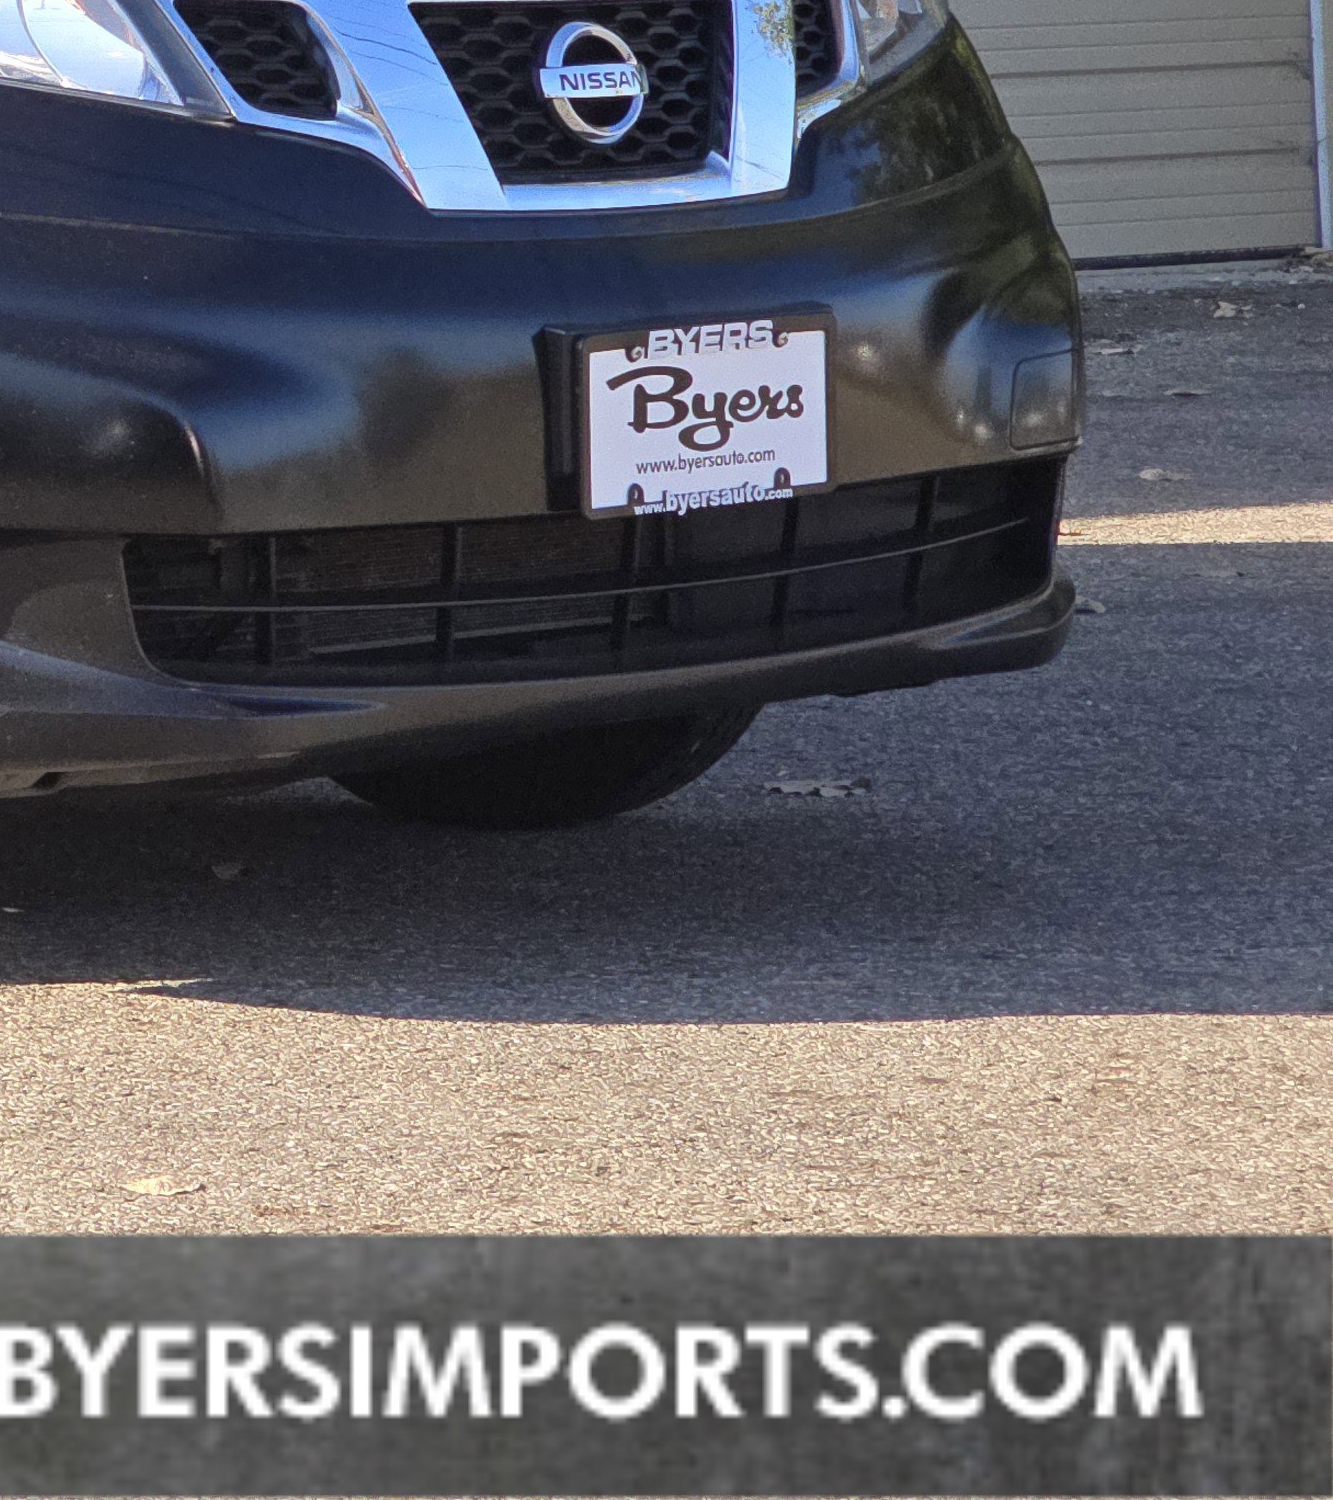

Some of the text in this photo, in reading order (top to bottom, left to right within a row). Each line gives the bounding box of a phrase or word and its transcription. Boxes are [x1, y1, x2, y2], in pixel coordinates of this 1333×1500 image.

[558, 71, 645, 91] NISSAN
[648, 319, 774, 360] BYERS
[606, 365, 804, 452] Byers
[635, 449, 776, 475] www.byersauto.com
[633, 481, 794, 516] www.byersauto.com
